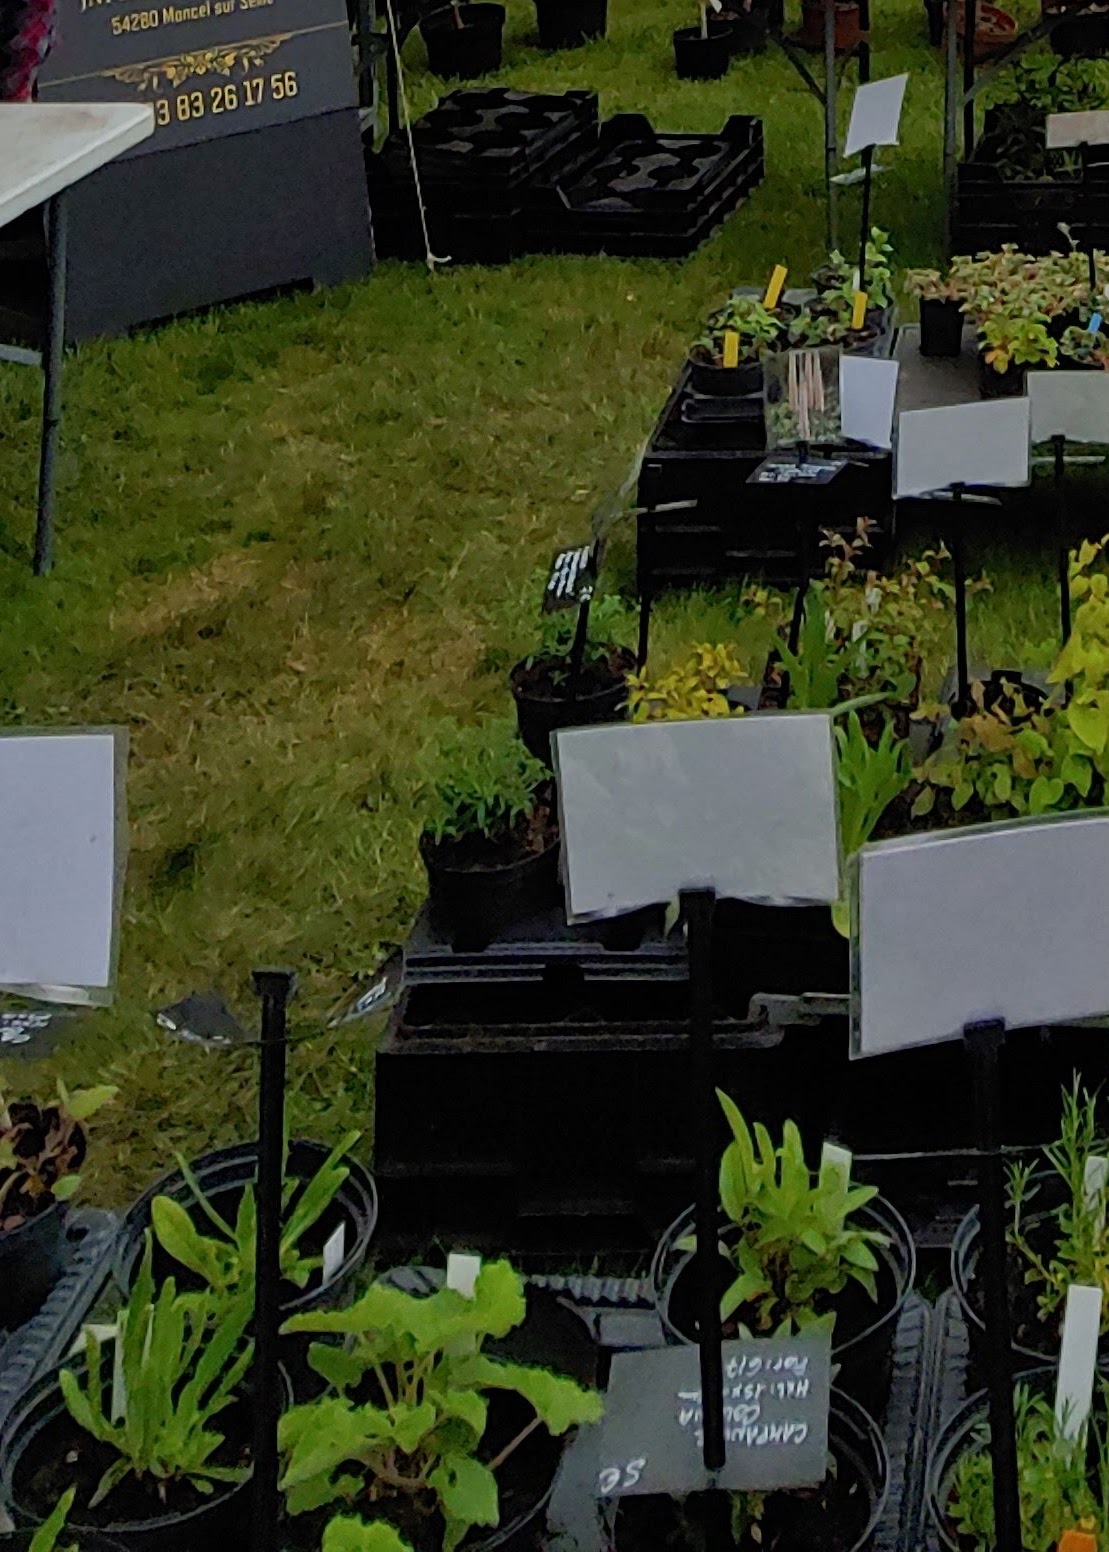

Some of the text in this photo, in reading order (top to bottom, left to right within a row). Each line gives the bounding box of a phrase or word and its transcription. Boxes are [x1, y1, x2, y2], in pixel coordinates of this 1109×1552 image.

[111, 9, 159, 36] 54280
[176, 90, 205, 121] 83
[210, 83, 239, 114] 26
[242, 77, 265, 106] 17
[270, 71, 298, 100] 56
